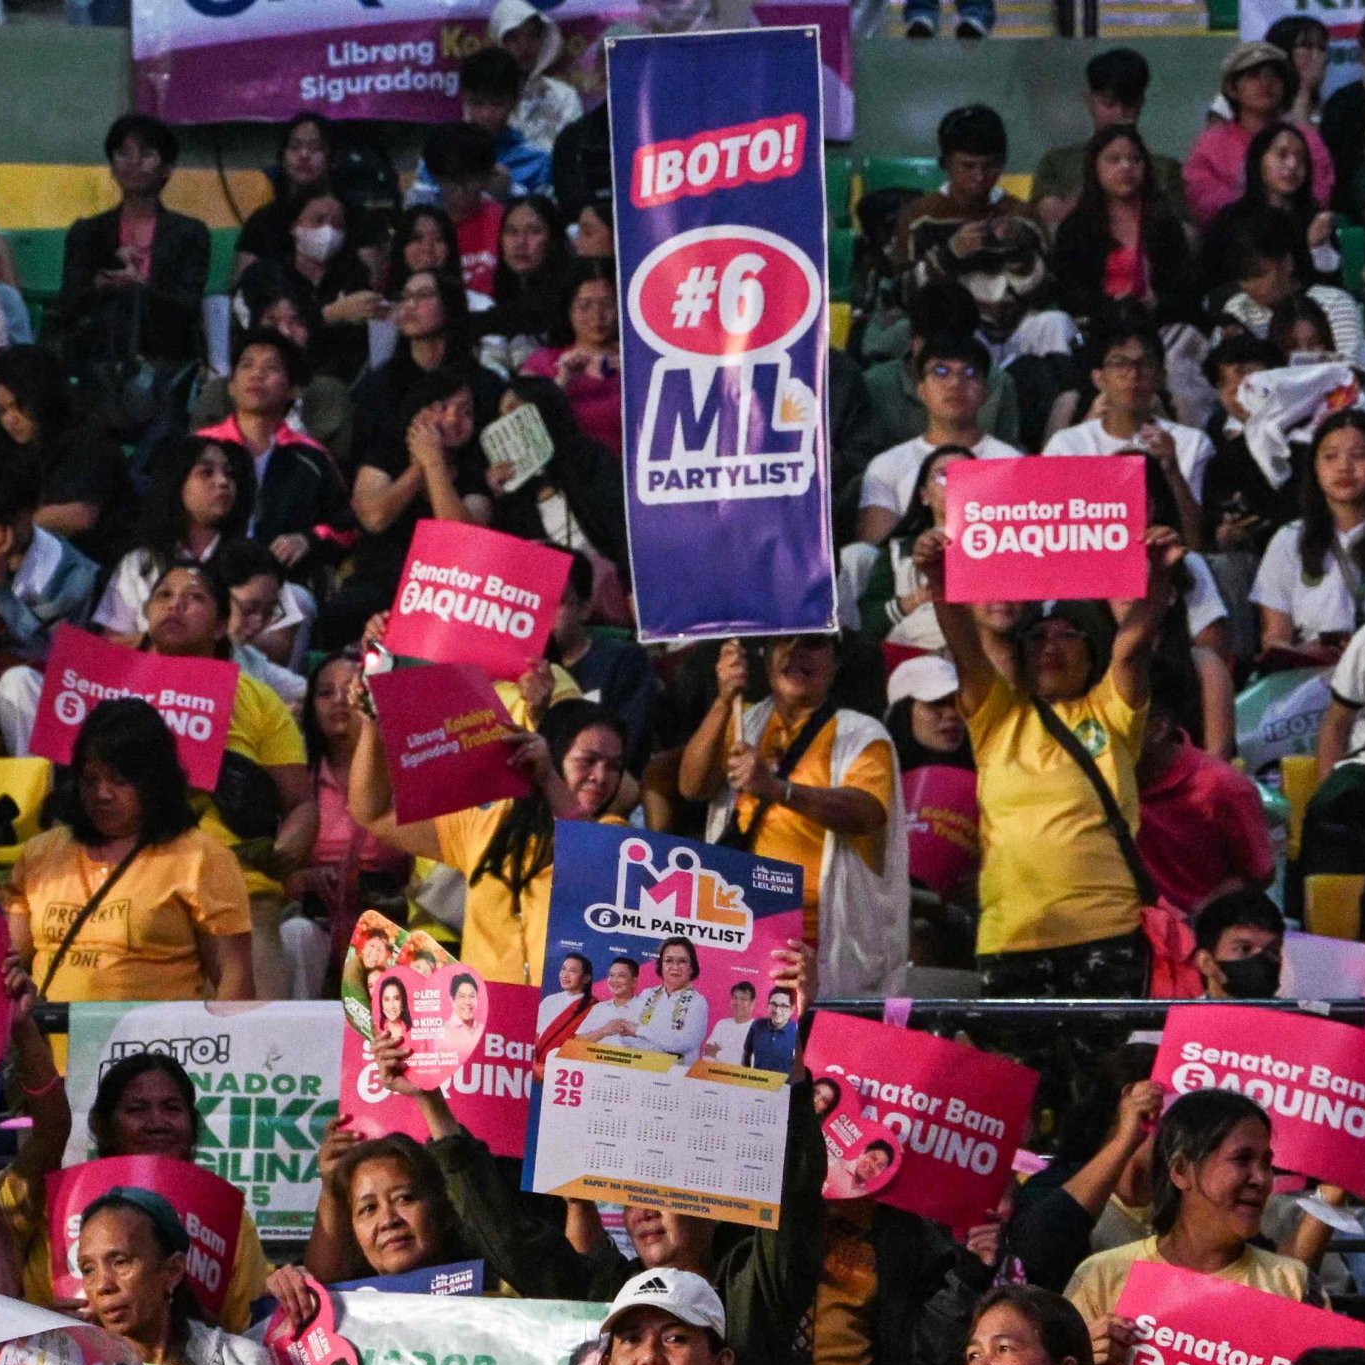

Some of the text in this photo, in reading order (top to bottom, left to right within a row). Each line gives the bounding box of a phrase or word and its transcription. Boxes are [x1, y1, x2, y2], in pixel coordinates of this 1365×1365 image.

[327, 38, 434, 69] Libreng
[300, 67, 462, 102] Siguradong
[638, 125, 798, 200] IBOTO!
[670, 251, 768, 336] #6
[648, 364, 805, 461] ML
[648, 461, 804, 492] PARTYLIST
[964, 498, 1127, 523] Senator Bam
[997, 523, 1129, 558] AQUINO
[410, 558, 542, 610] Senator Bam
[417, 584, 535, 639] AQUINO
[159, 682, 216, 714] Bam
[48, 903, 127, 926] PROERTY
[622, 915, 745, 944] ML PARTYLIST
[555, 1069, 584, 1088] 20
[1181, 1041, 1305, 1088] Senator
[194, 1072, 322, 1095] NADOR
[553, 1089, 582, 1108] 25
[946, 1097, 1006, 1140] Bam
[186, 1212, 227, 1254] Bam
